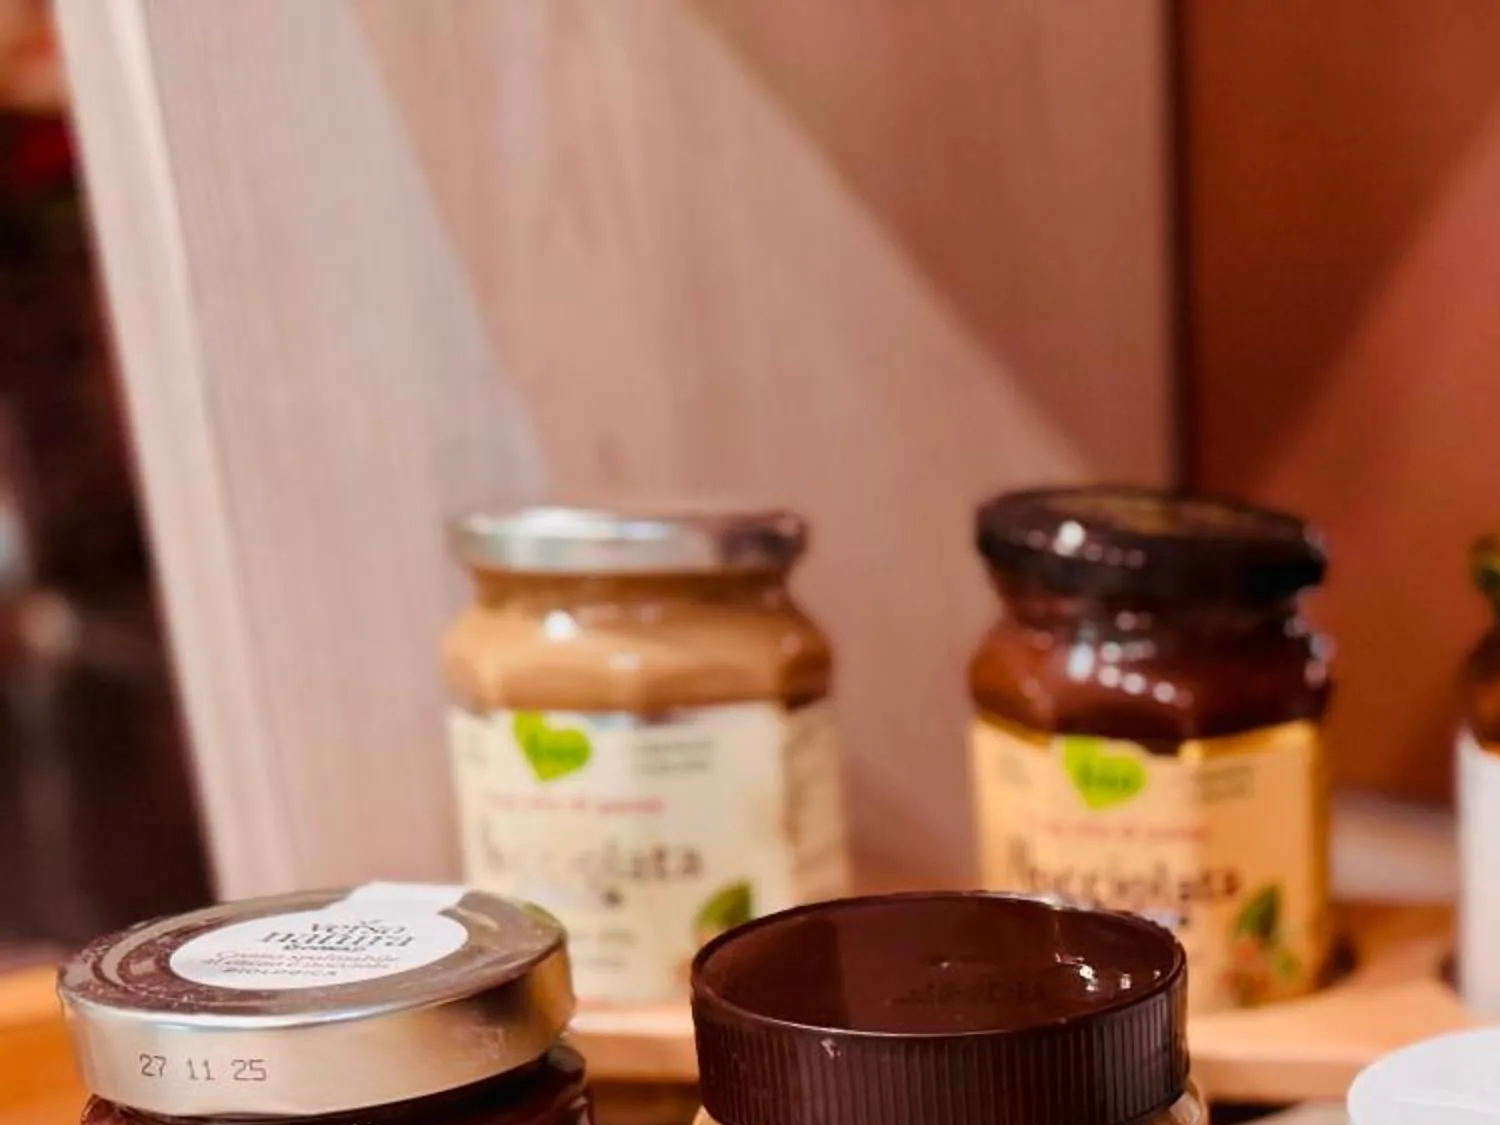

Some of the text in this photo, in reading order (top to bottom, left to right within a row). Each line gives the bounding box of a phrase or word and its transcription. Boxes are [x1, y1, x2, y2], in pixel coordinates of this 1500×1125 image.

[139, 1053, 267, 1082] 27 11 25
